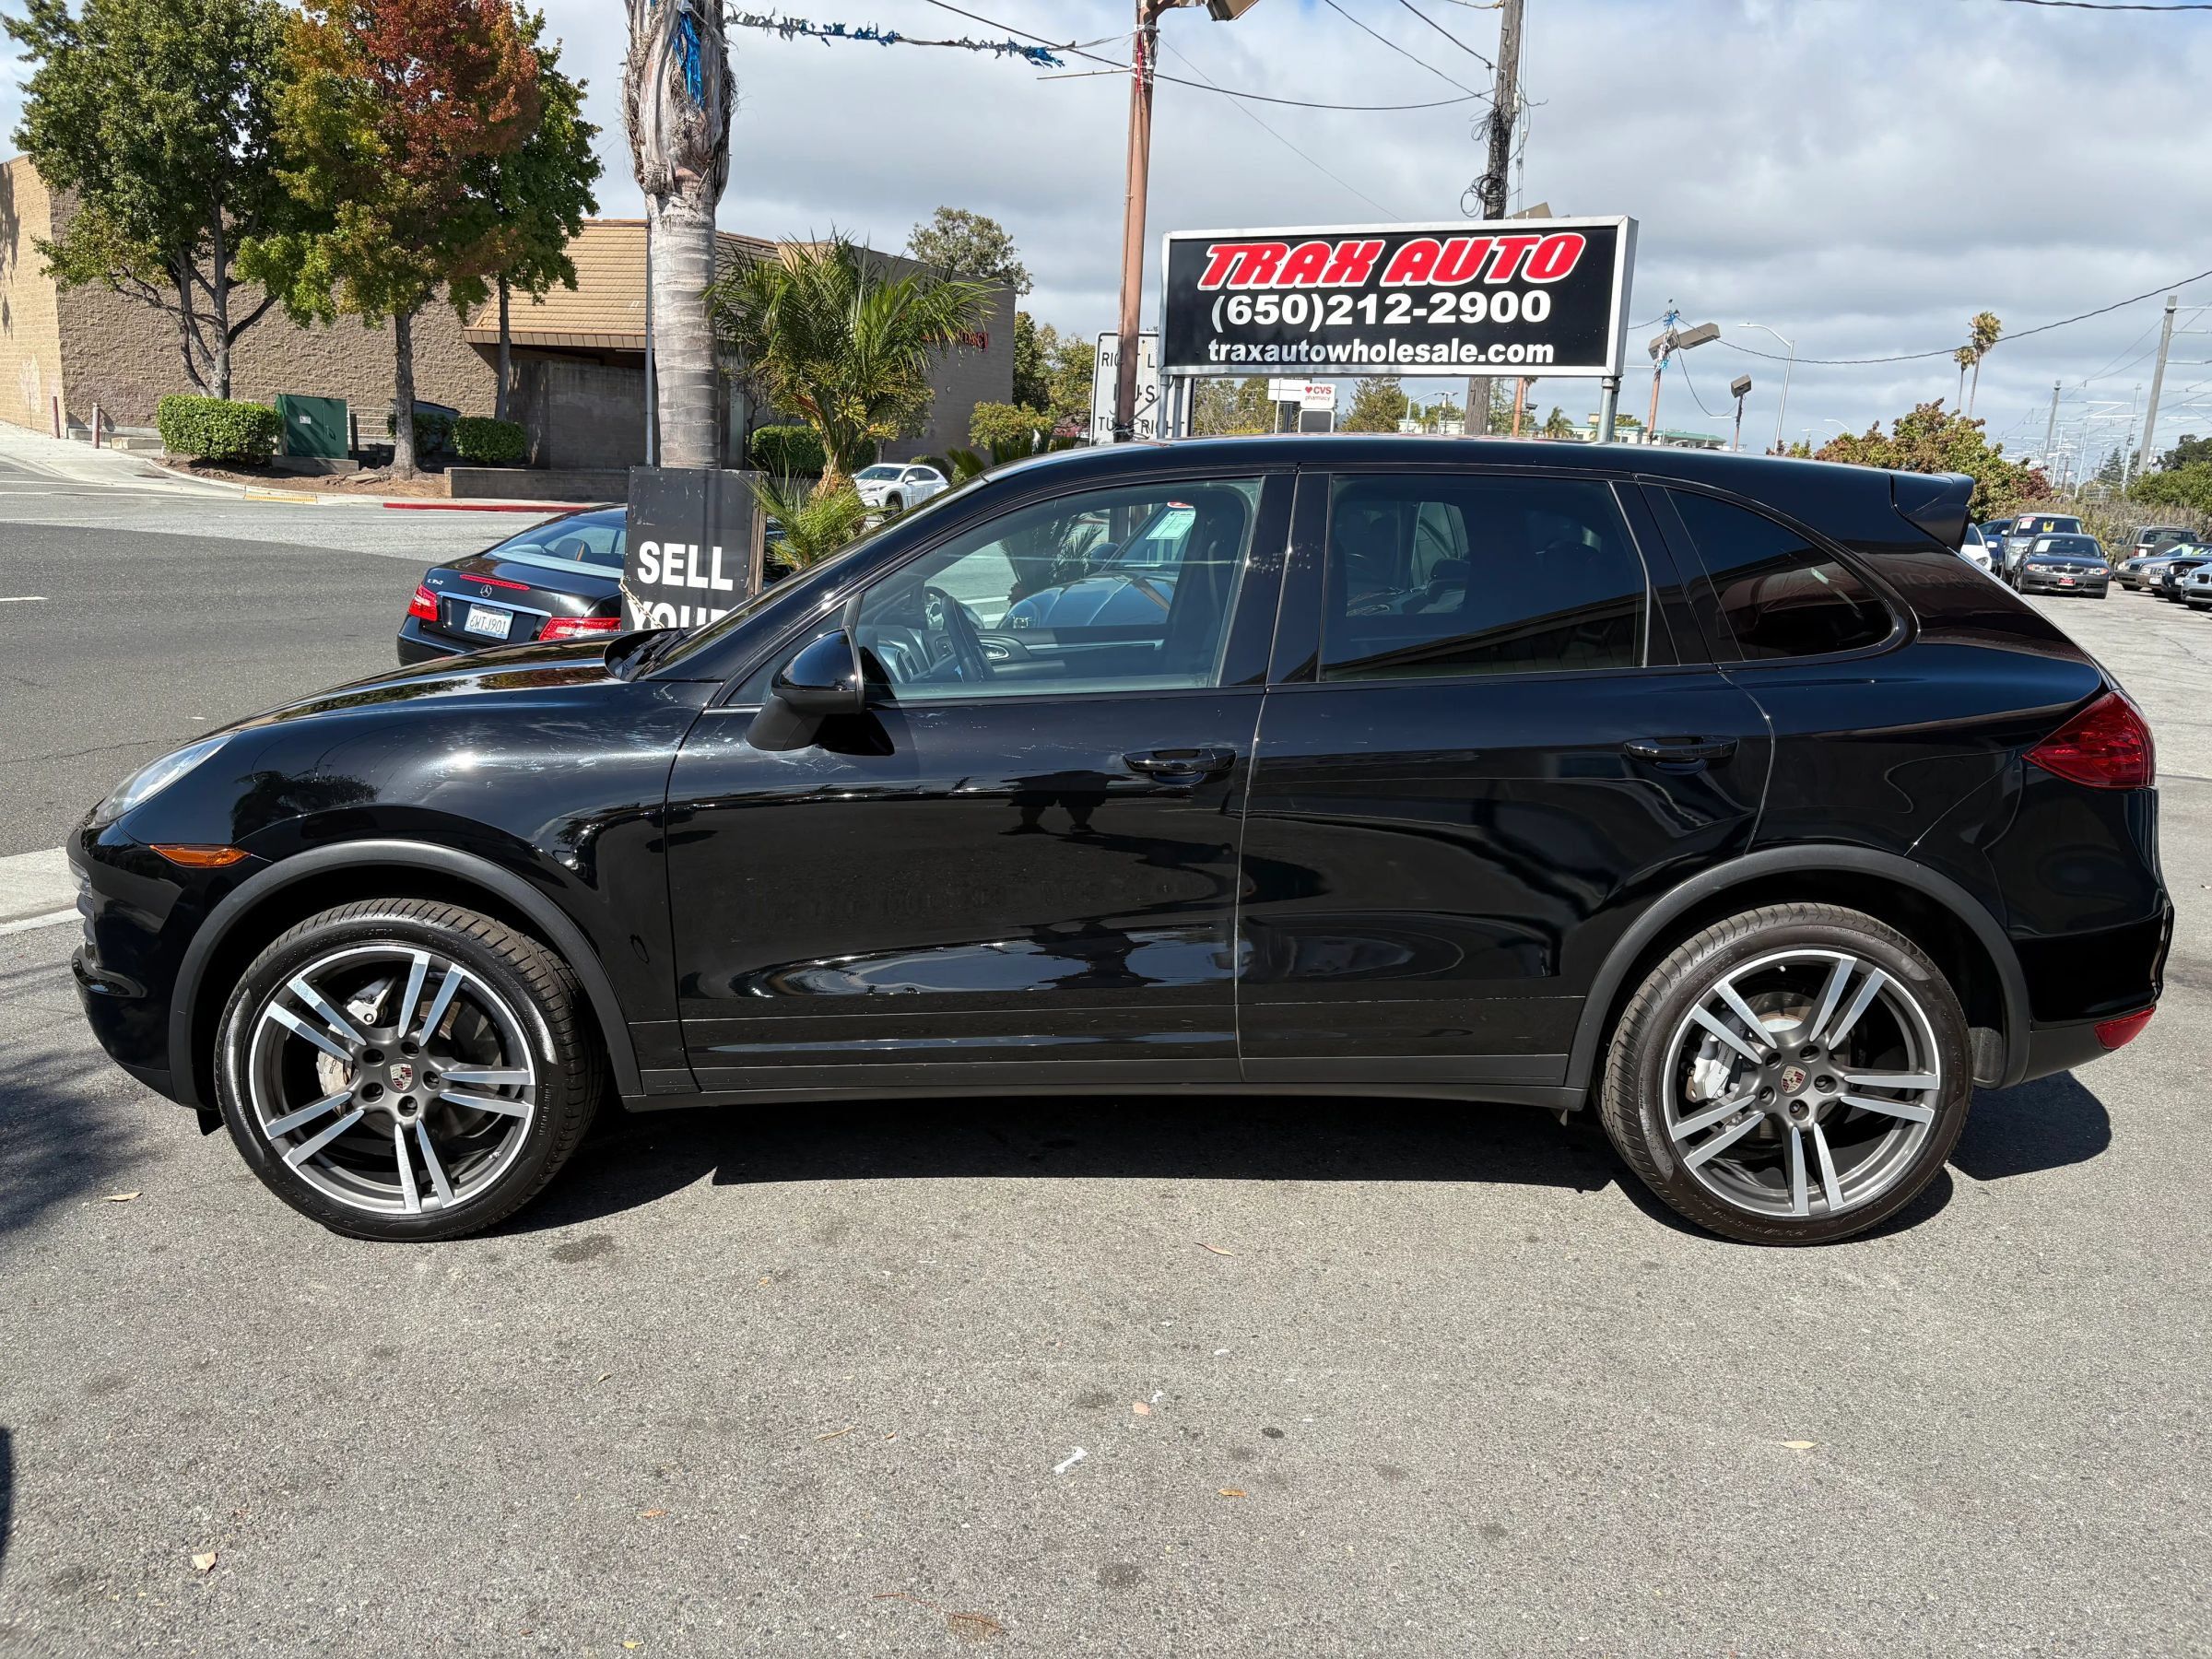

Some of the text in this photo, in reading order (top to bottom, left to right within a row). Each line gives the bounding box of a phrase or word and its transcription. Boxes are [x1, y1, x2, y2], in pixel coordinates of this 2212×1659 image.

[1197, 232, 1586, 290] TRAX AUTO
[1211, 289, 1551, 333] (650)212-2900
[1208, 337, 1554, 362] traxautowholesale.com
[1313, 386, 1332, 394] CVS
[637, 541, 734, 591] SELL
